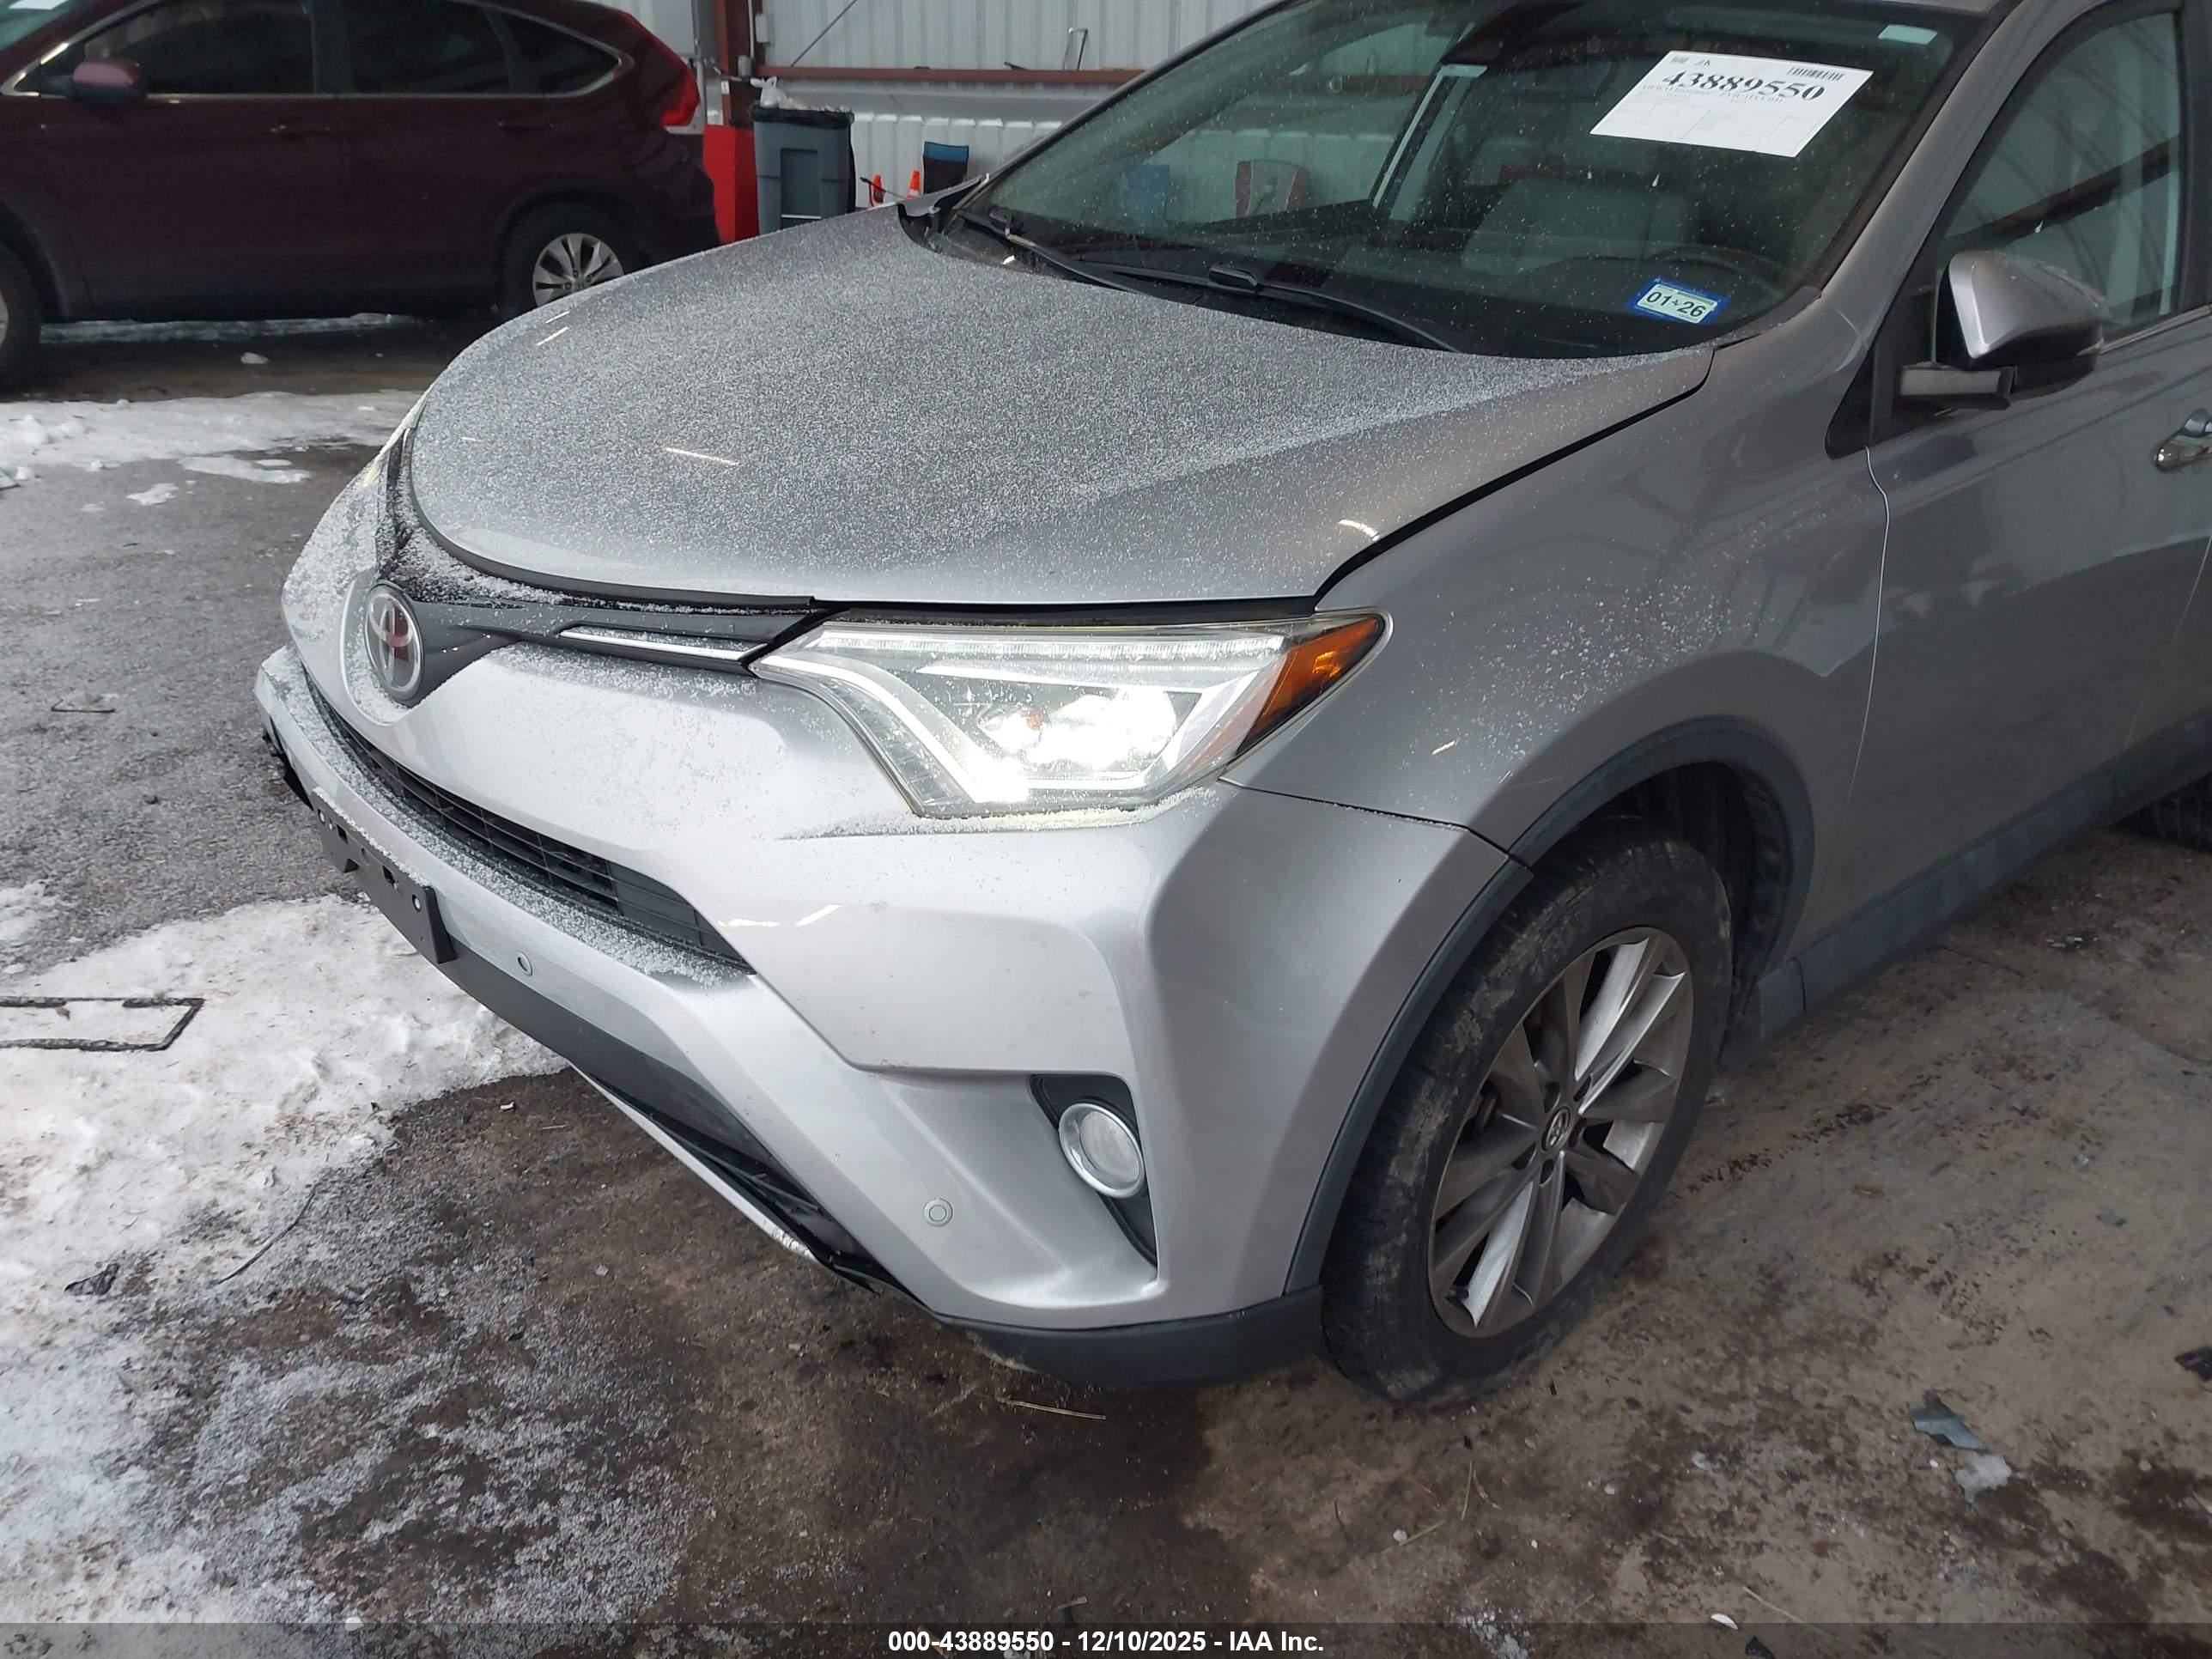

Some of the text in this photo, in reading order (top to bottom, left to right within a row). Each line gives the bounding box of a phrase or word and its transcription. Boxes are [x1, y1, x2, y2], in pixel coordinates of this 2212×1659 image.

[1663, 70, 1826, 101] 43889550
[1646, 291, 1673, 307] 01
[1676, 301, 1707, 318] 26
